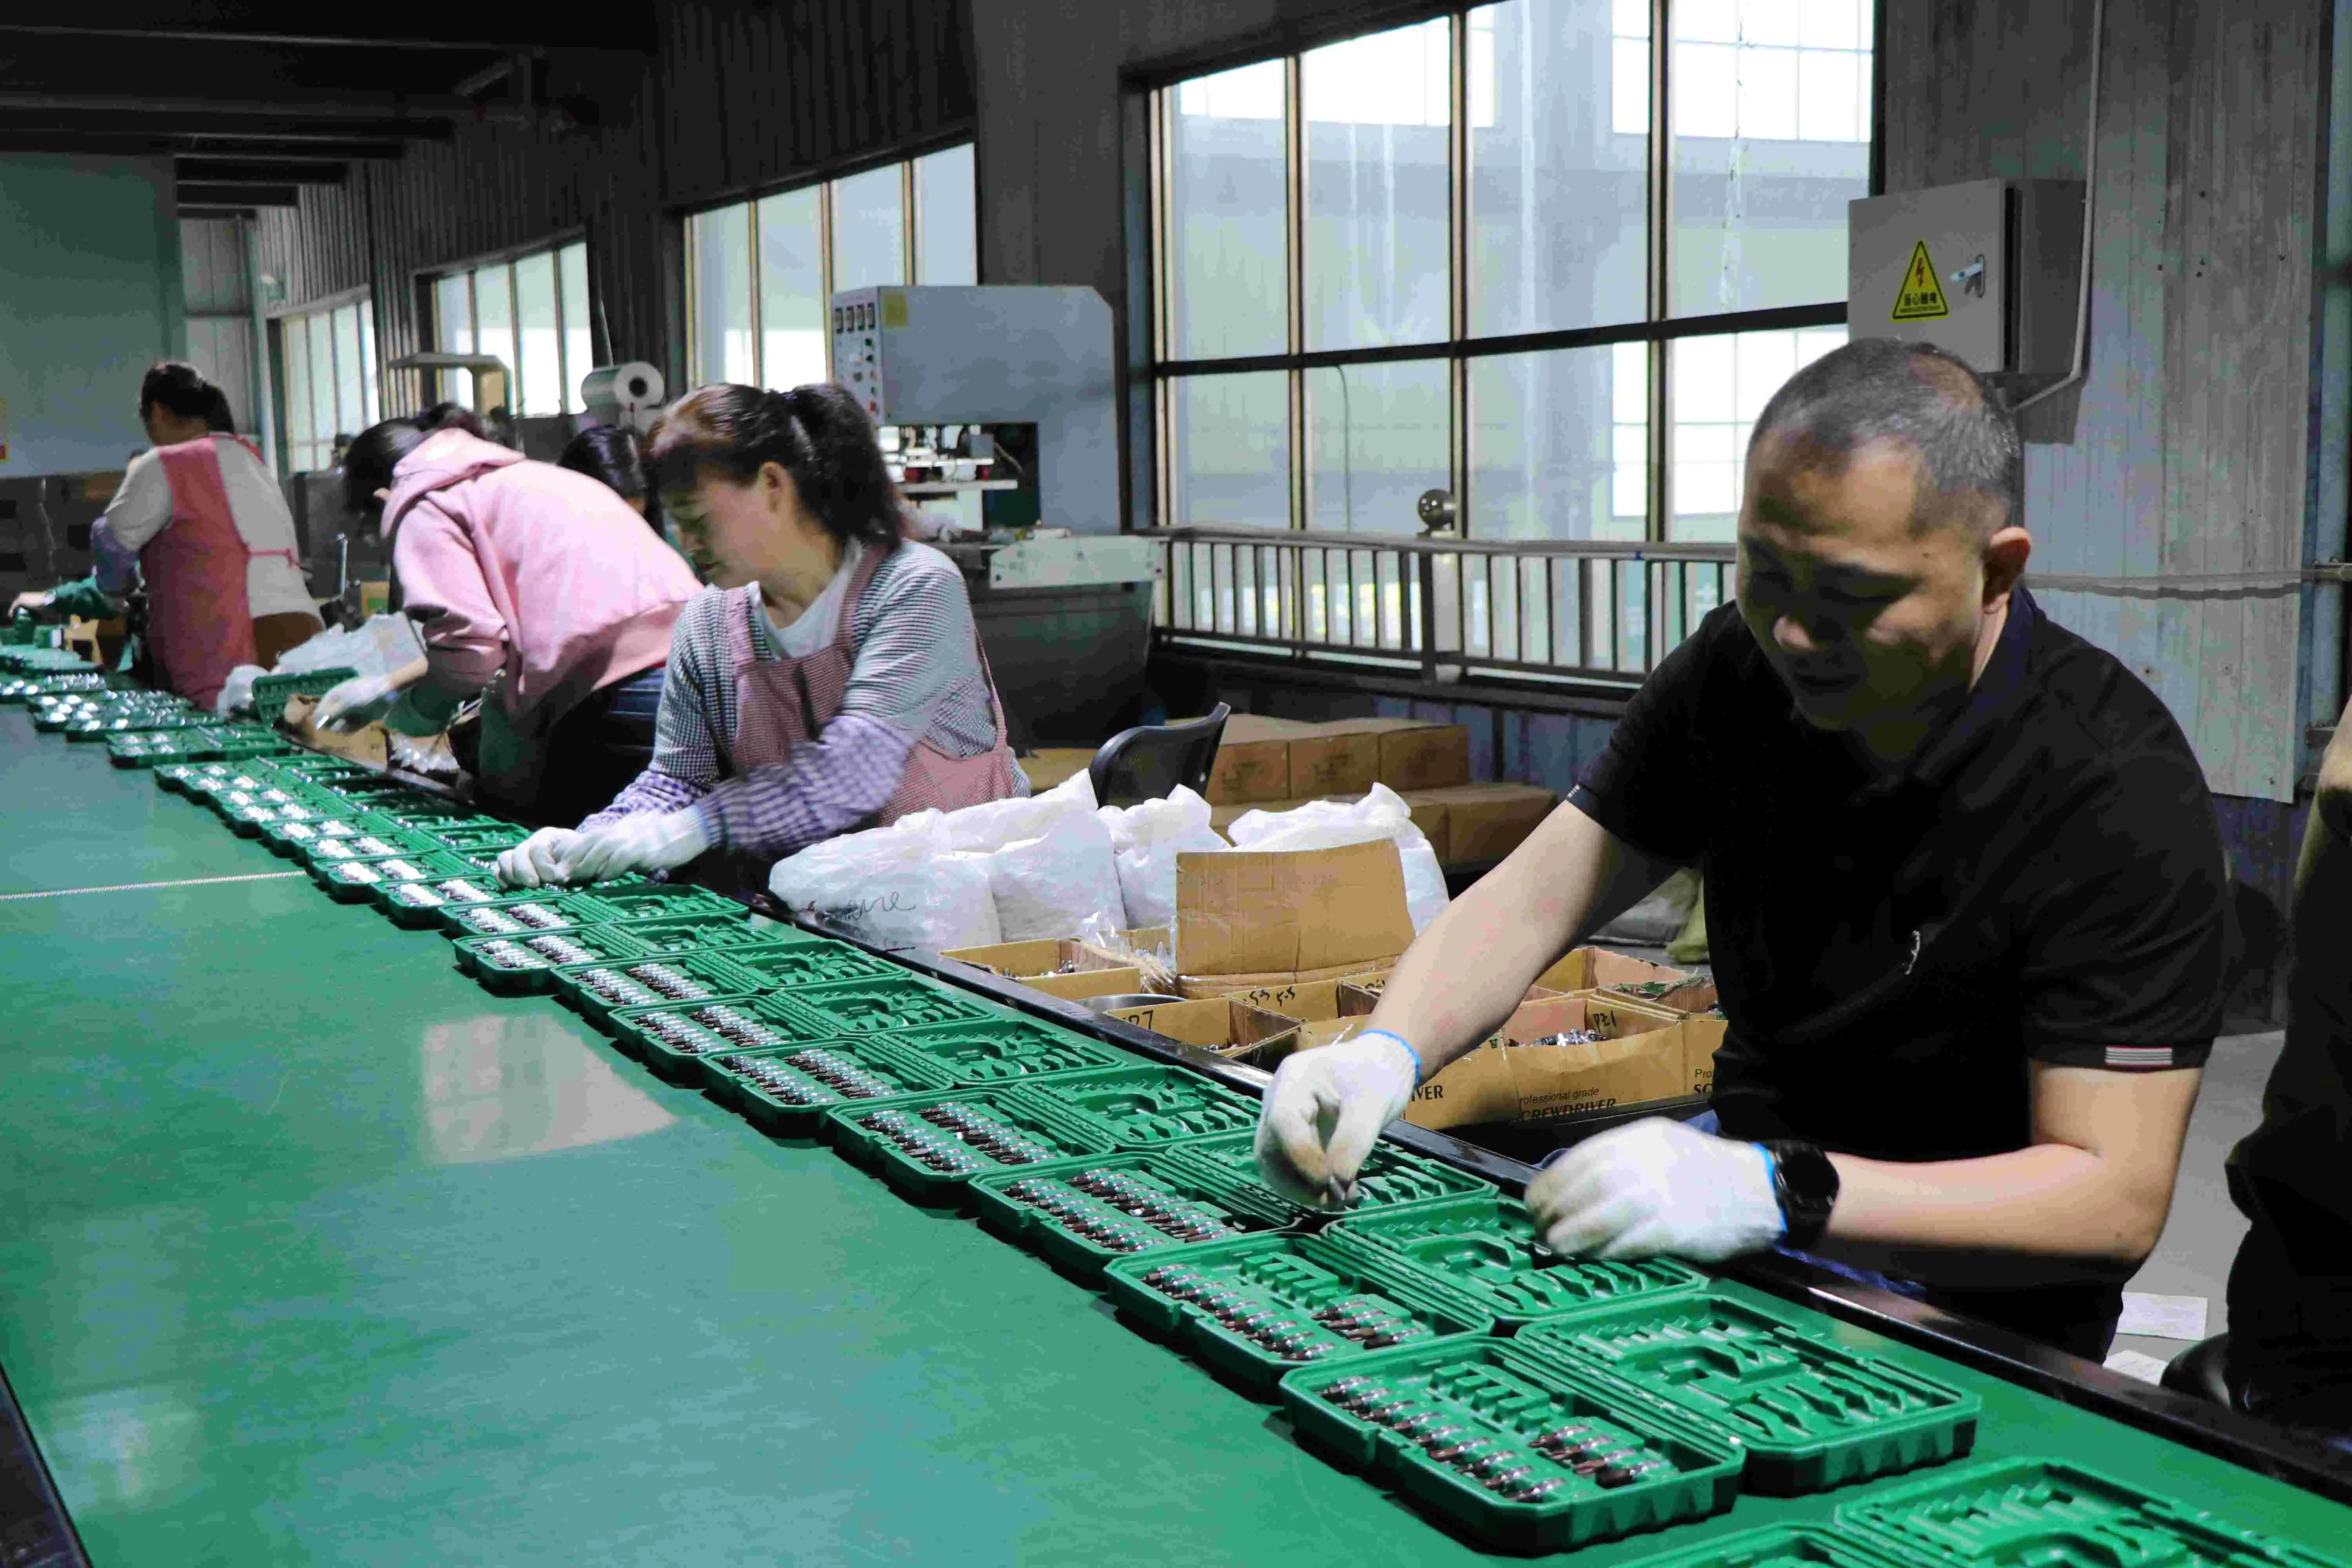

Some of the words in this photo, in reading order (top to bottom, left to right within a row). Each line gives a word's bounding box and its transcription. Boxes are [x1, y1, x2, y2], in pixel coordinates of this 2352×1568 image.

[1695, 1069, 1713, 1079] Pro
[1411, 1085, 1444, 1102] IVER
[1520, 1089, 1571, 1105] rofessional
[1573, 1087, 1599, 1100] grade
[1522, 1098, 1616, 1122] CREWDRIVER
